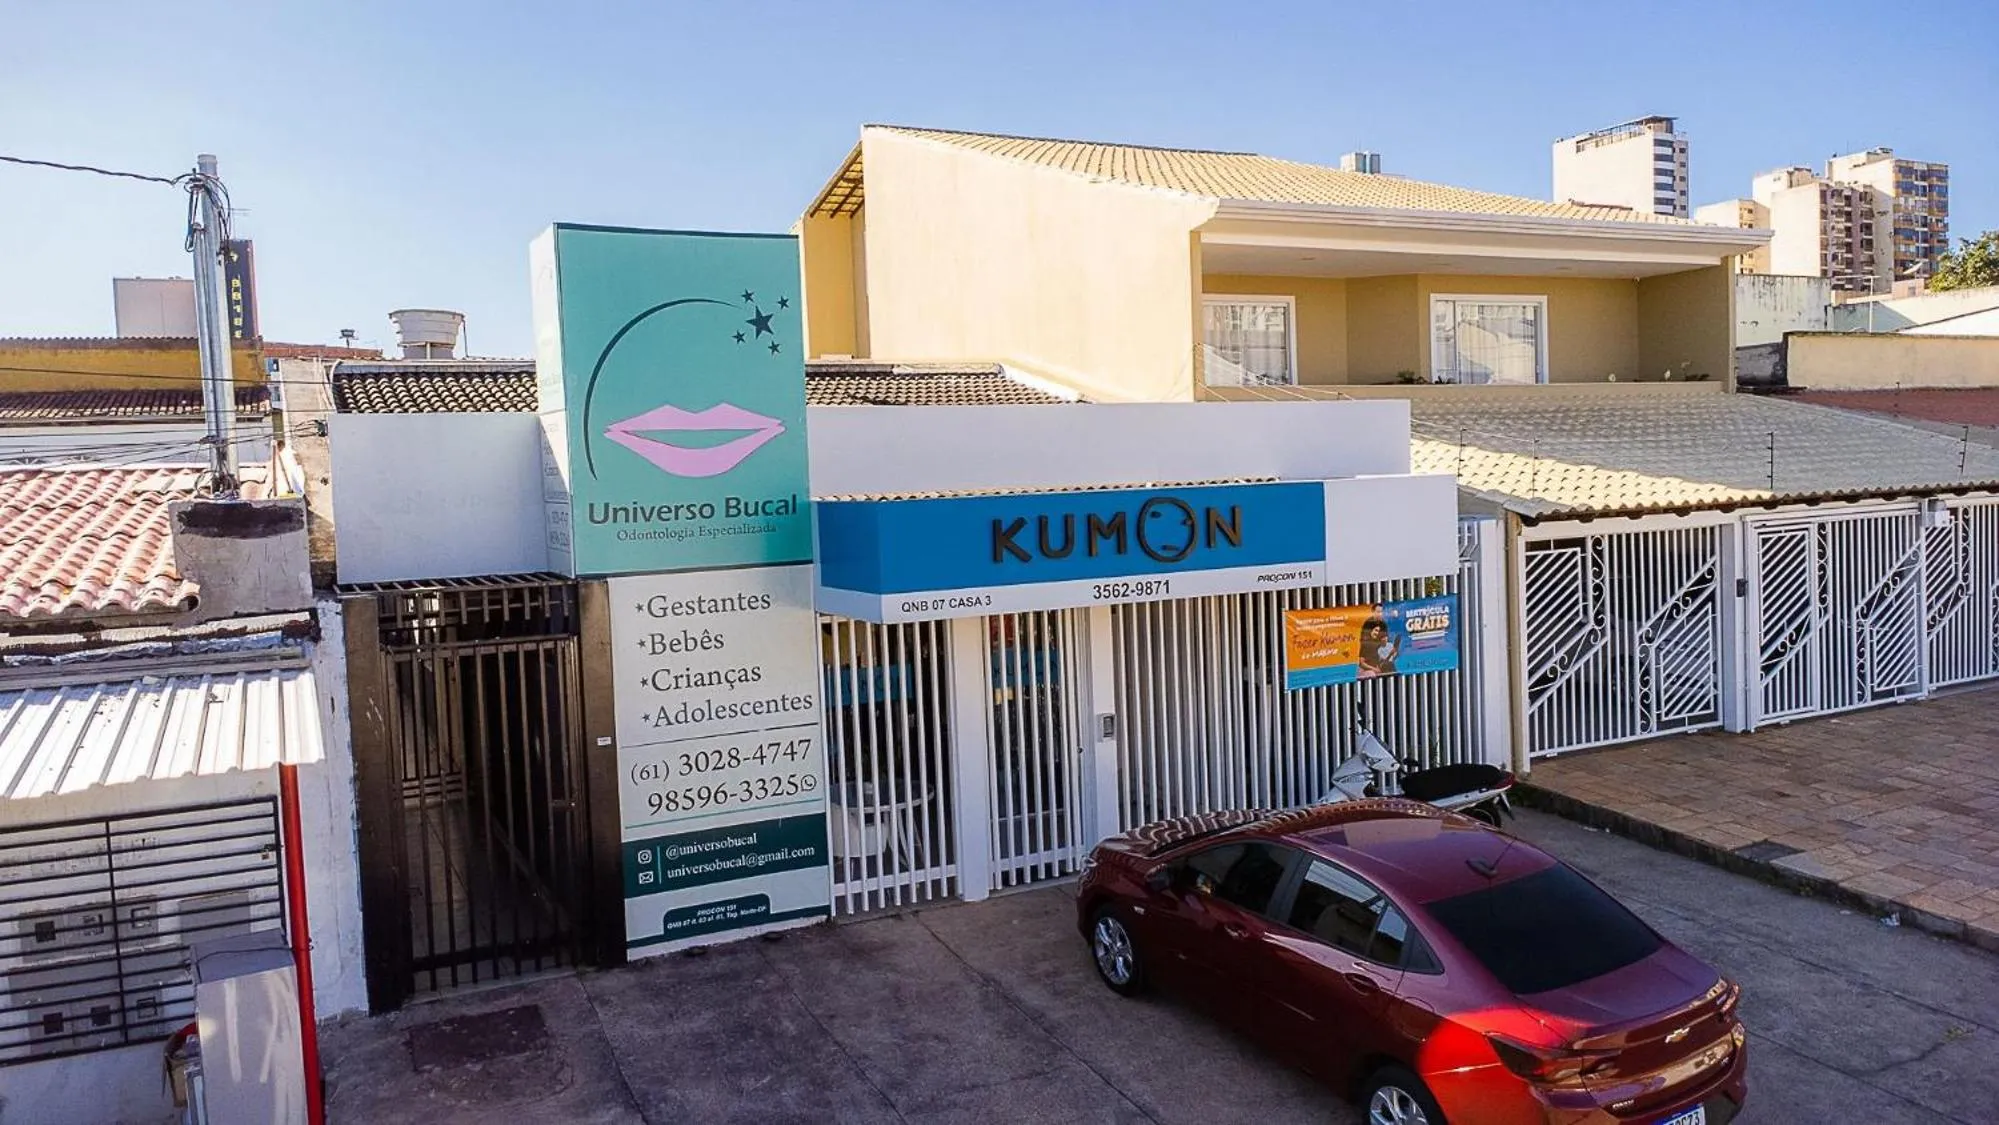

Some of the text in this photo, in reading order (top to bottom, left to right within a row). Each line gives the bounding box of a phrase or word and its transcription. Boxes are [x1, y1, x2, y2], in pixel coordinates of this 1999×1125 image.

[588, 501, 715, 525] Universo
[725, 494, 797, 518] Bucal
[617, 523, 777, 542] Odontologia Especializada
[992, 496, 1242, 564] KUMON
[1093, 579, 1171, 600] 3562-9871
[647, 592, 771, 618] Gestantes
[901, 595, 992, 613] QNB 07 CASA 3
[1405, 615, 1450, 632] GRÁTIS
[648, 628, 725, 656] Bebês
[651, 665, 762, 692] Crianças
[653, 694, 813, 728] Adolescentes
[631, 739, 812, 786] (61) 3028-4747
[648, 774, 799, 816] 98596-3325
[665, 833, 757, 860] @universobucal
[667, 846, 815, 879] universobucal@gmail.com
